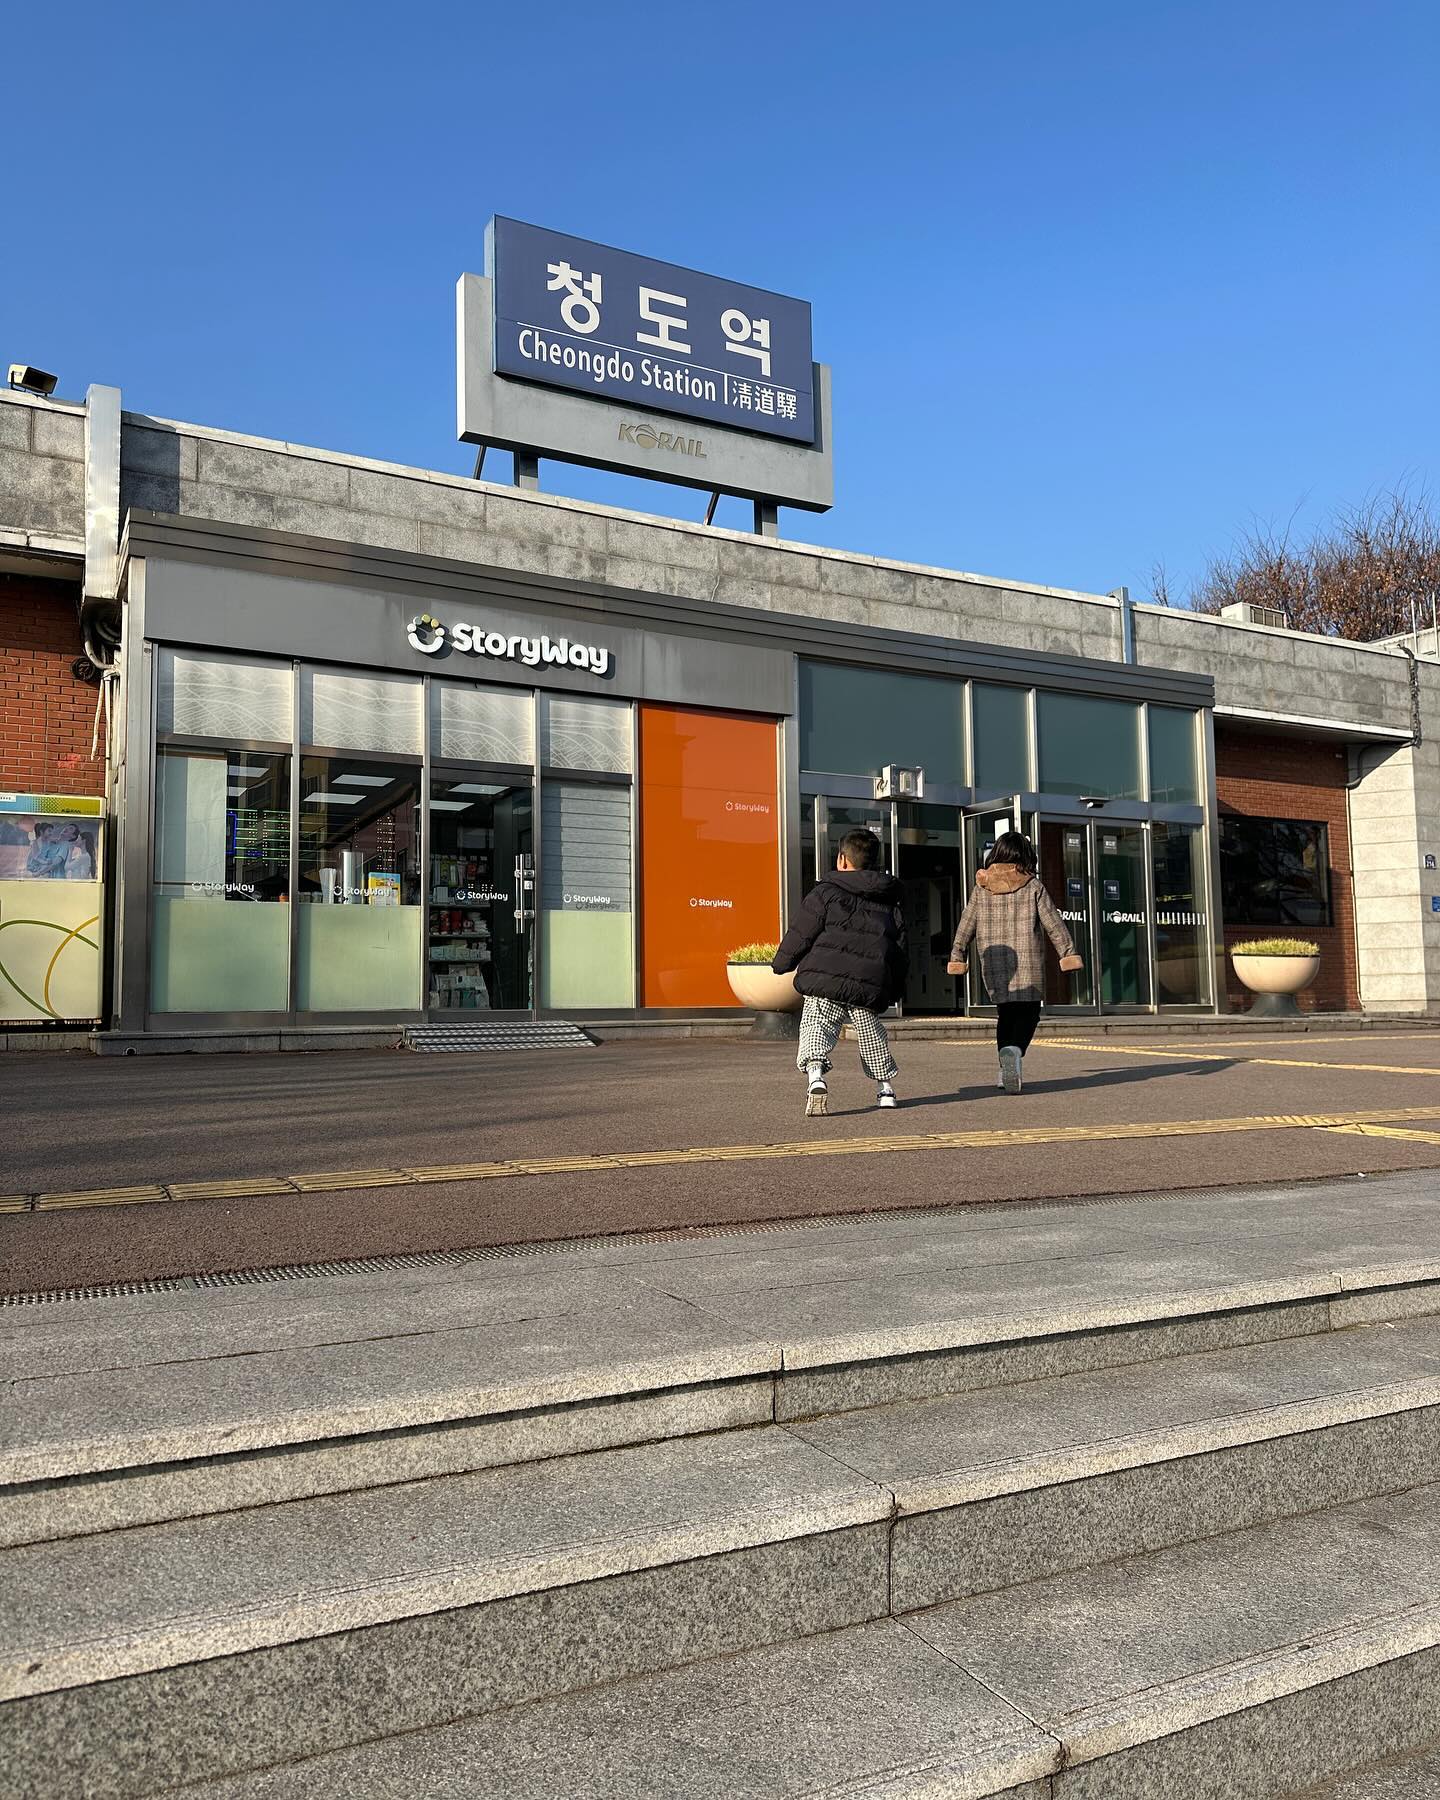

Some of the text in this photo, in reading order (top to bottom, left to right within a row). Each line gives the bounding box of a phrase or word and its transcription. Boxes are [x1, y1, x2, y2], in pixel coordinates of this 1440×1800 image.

[518, 328, 717, 402] Cheongdo Station
[617, 423, 707, 459] KORAIL
[451, 622, 609, 675] StoryWay
[734, 802, 770, 813] StoryWay
[204, 881, 255, 893] StoryWay
[467, 891, 509, 901] StoryWay
[572, 894, 611, 904] StoryWay
[698, 898, 733, 908] StoryWay
